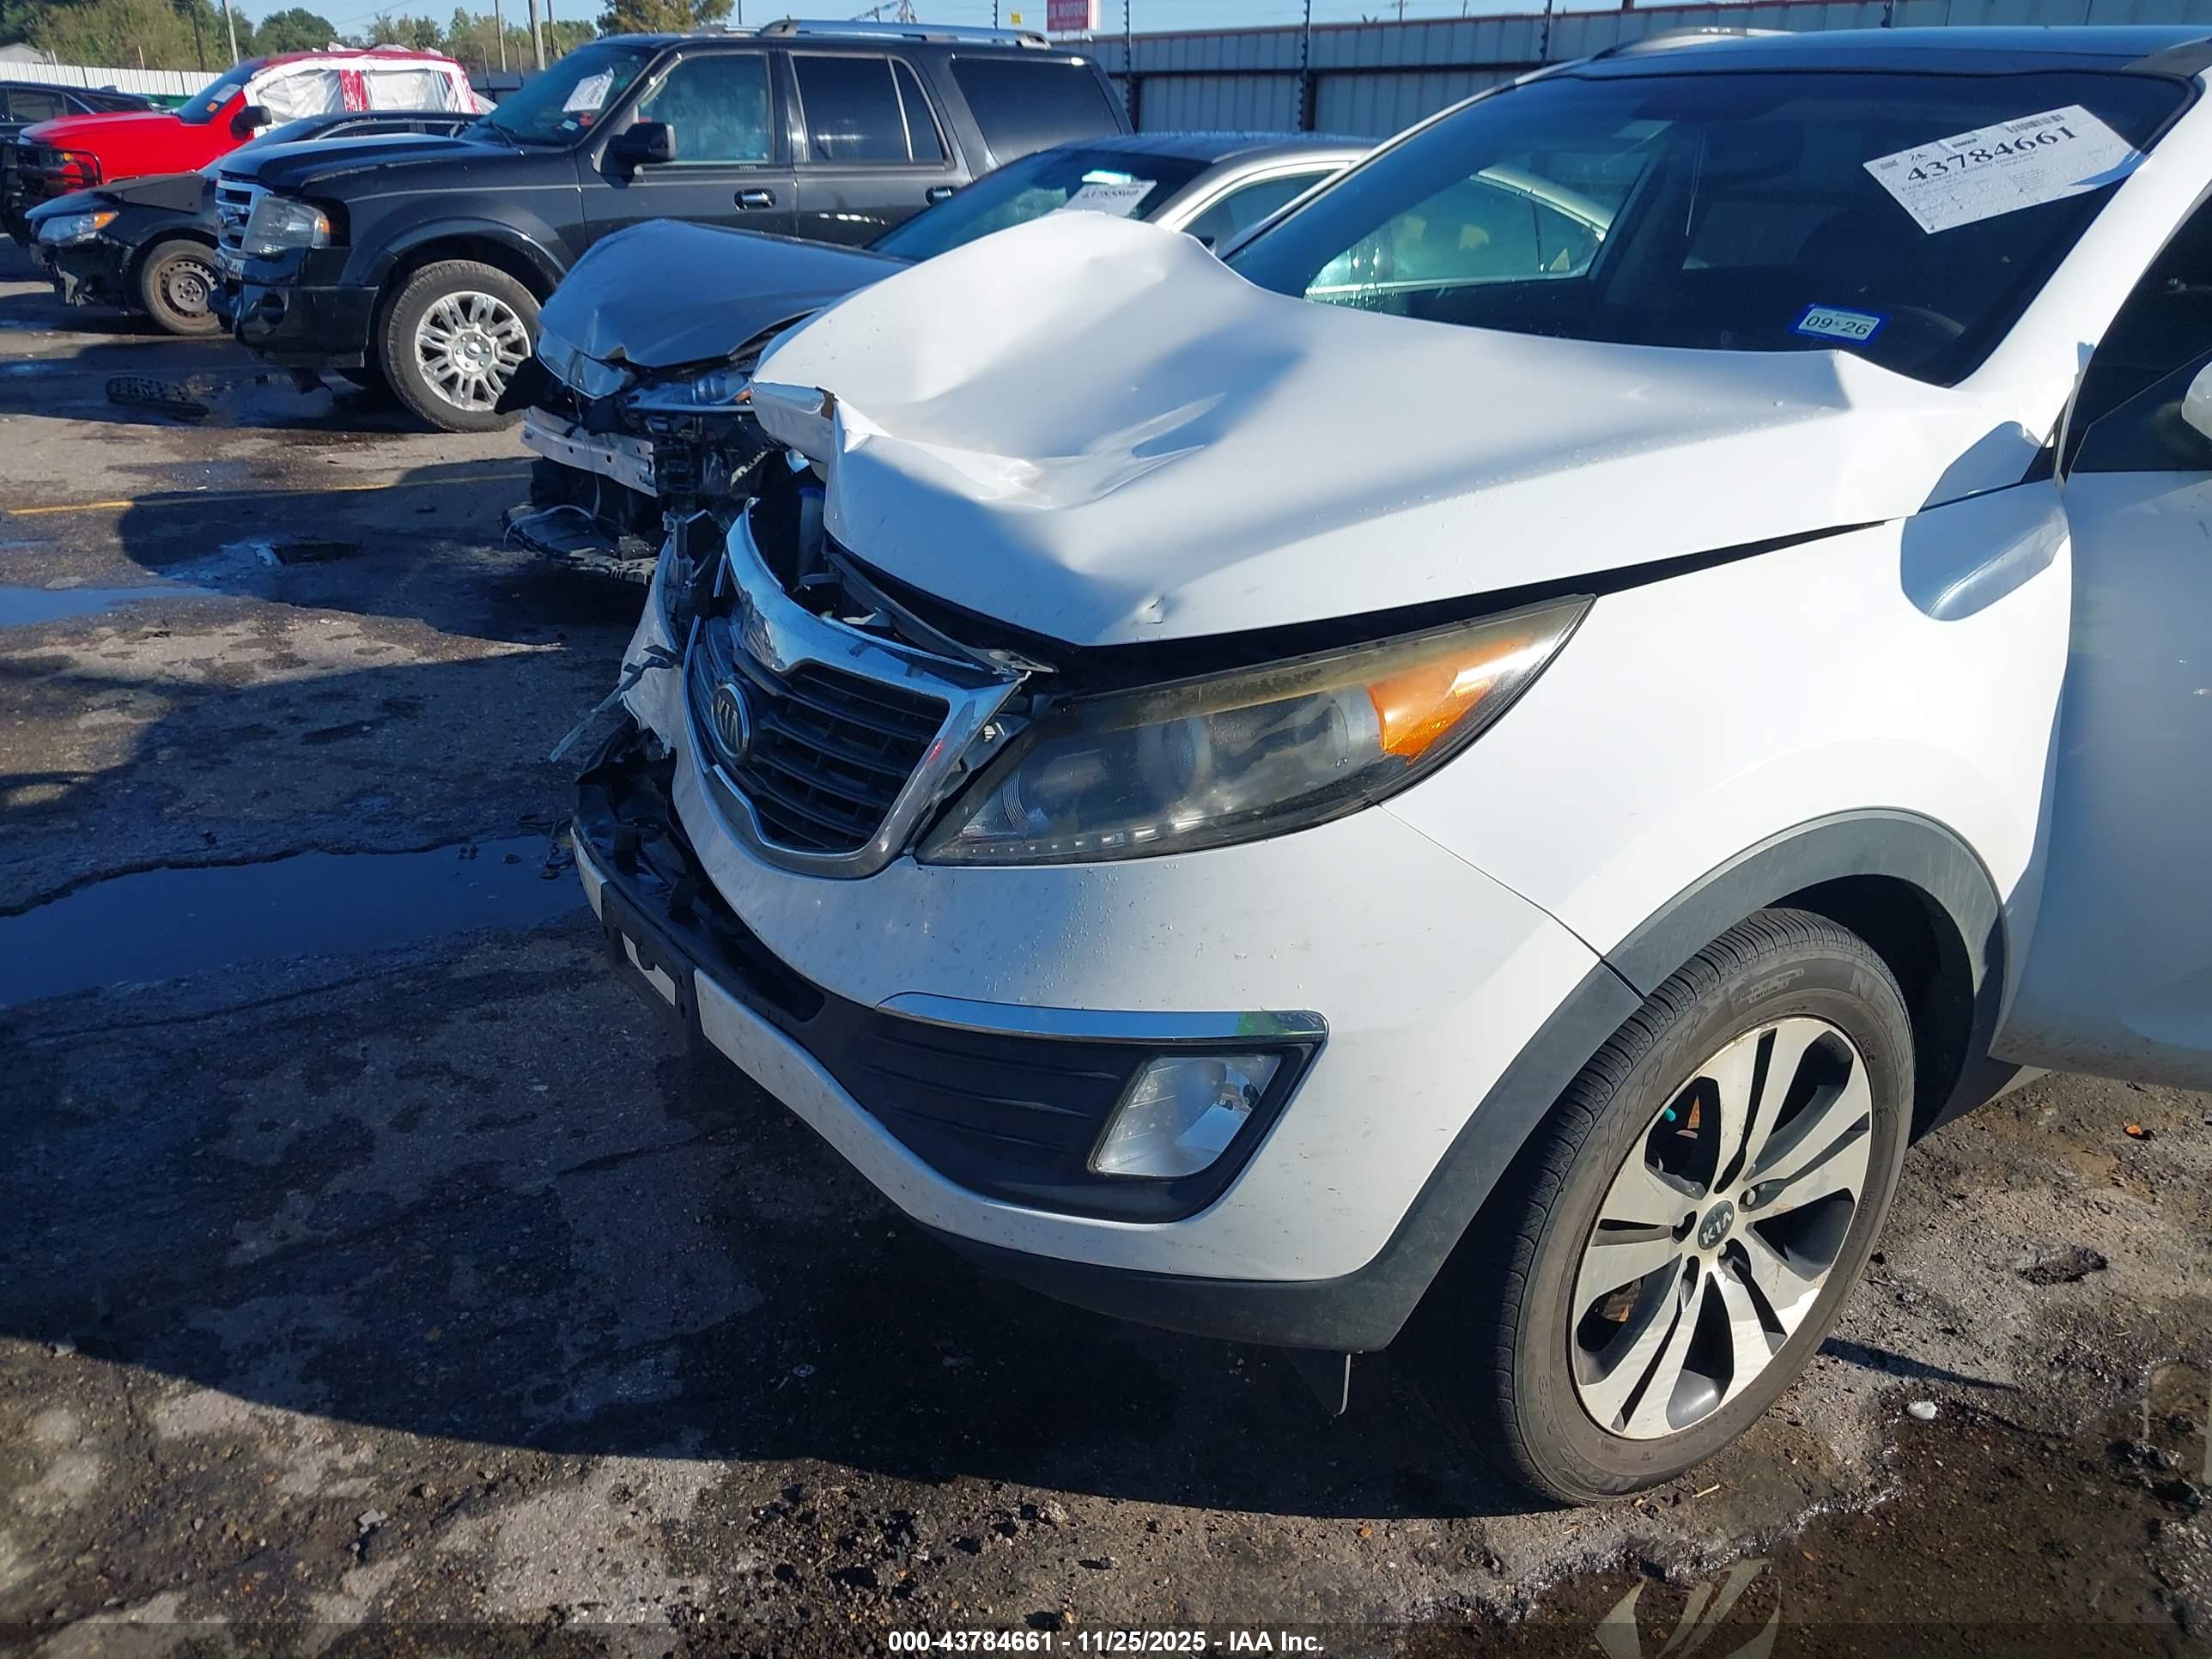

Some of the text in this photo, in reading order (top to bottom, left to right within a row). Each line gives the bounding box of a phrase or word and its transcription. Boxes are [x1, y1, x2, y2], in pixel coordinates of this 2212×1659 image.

[1907, 125, 2077, 181] 43784661
[1806, 315, 1833, 329] 09
[1840, 321, 1870, 335] 26
[1702, 1211, 1732, 1244] KIA
